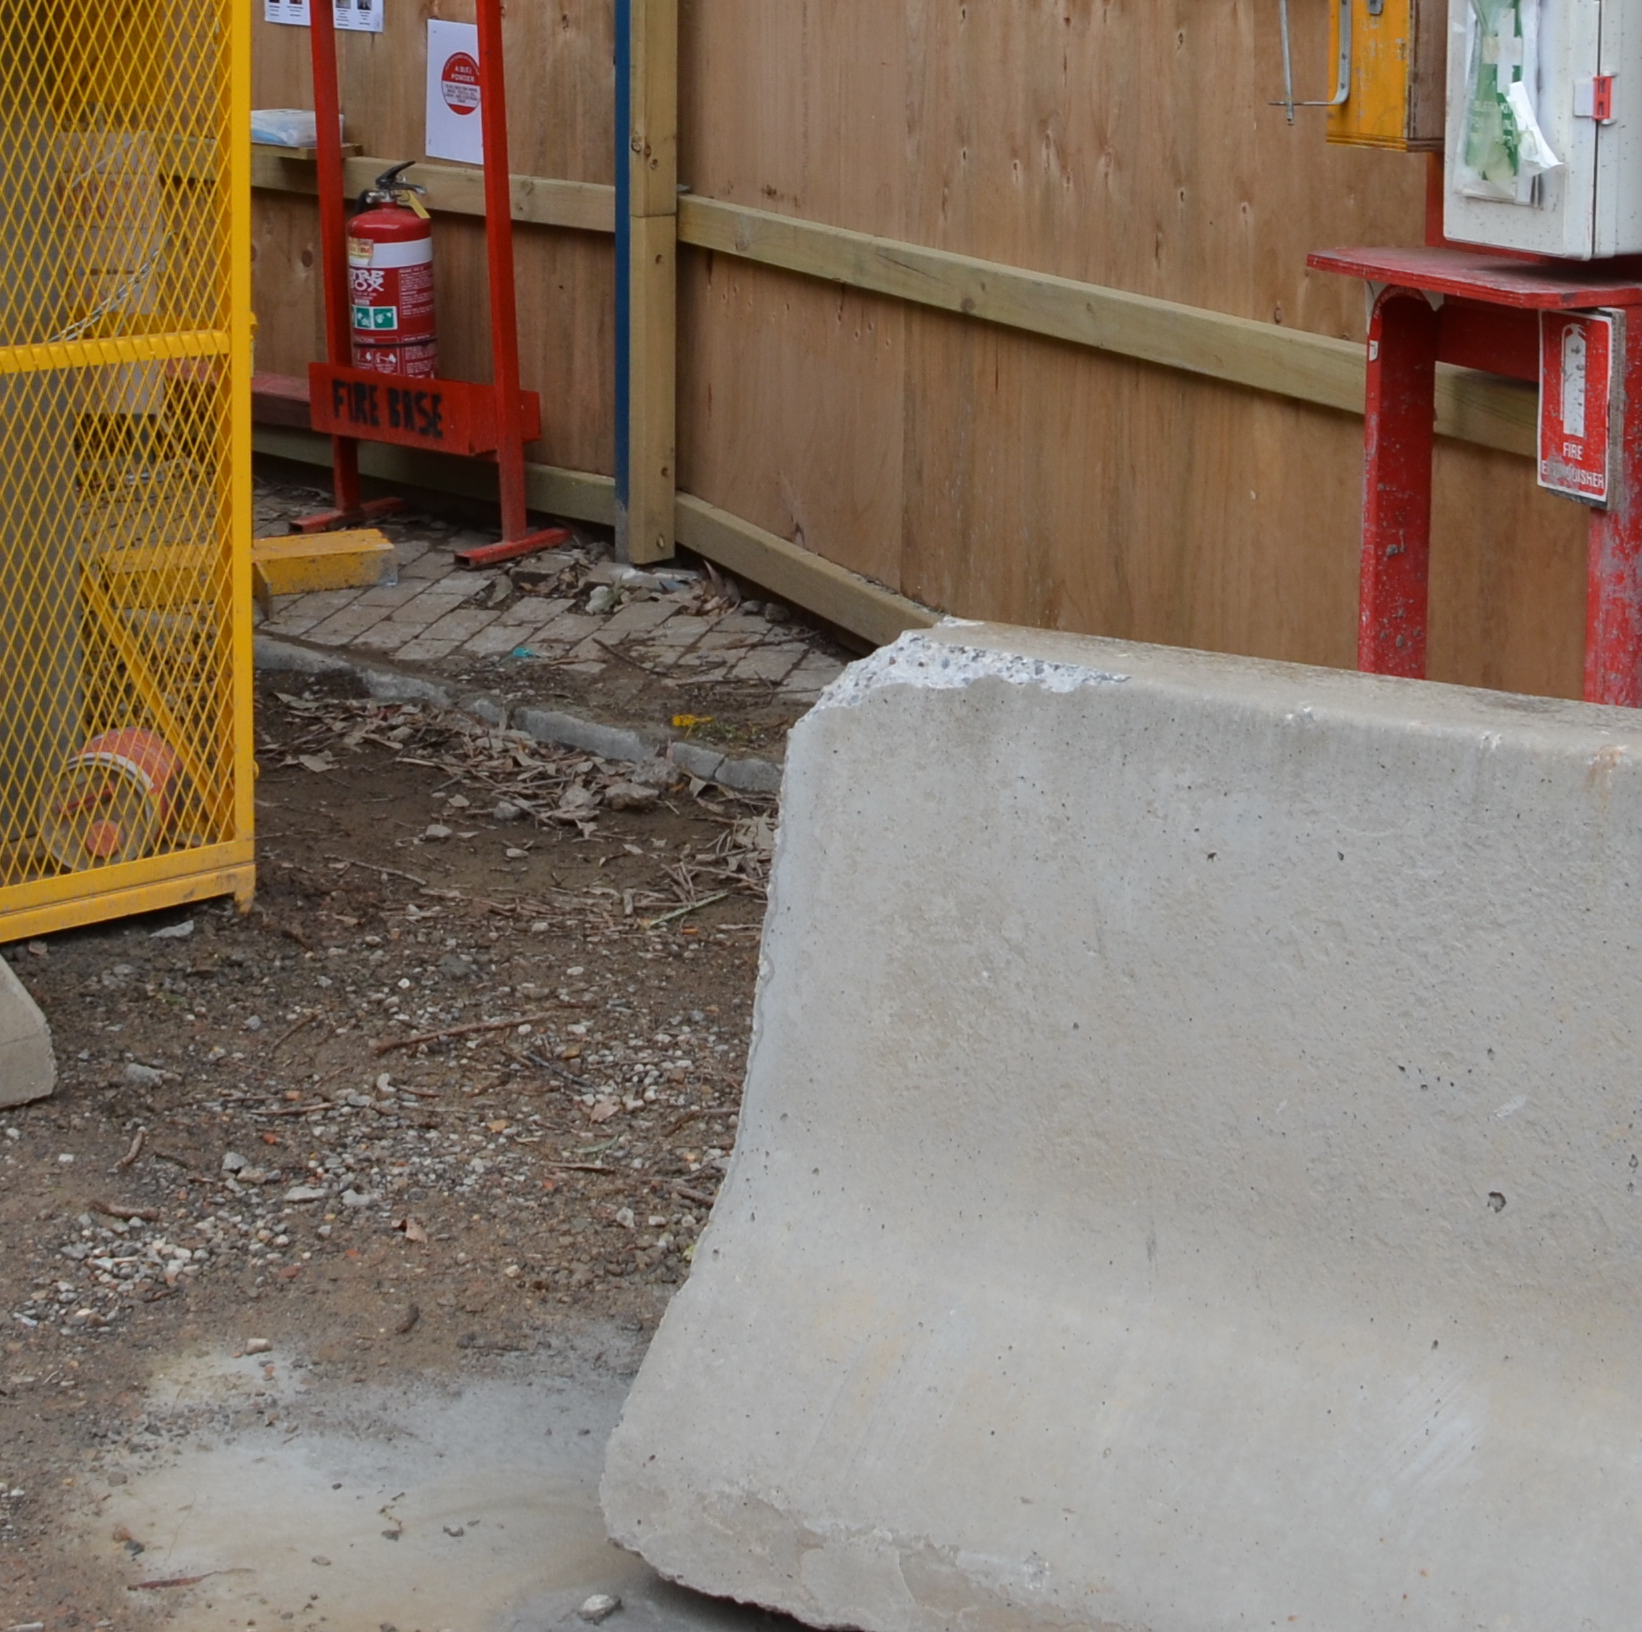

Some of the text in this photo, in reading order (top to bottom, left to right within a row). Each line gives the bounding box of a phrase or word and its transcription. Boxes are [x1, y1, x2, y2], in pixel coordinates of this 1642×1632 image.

[332, 378, 443, 439] FIRE BASE
[1563, 441, 1583, 461] FIRE
[1541, 460, 1605, 489] EUISHER
